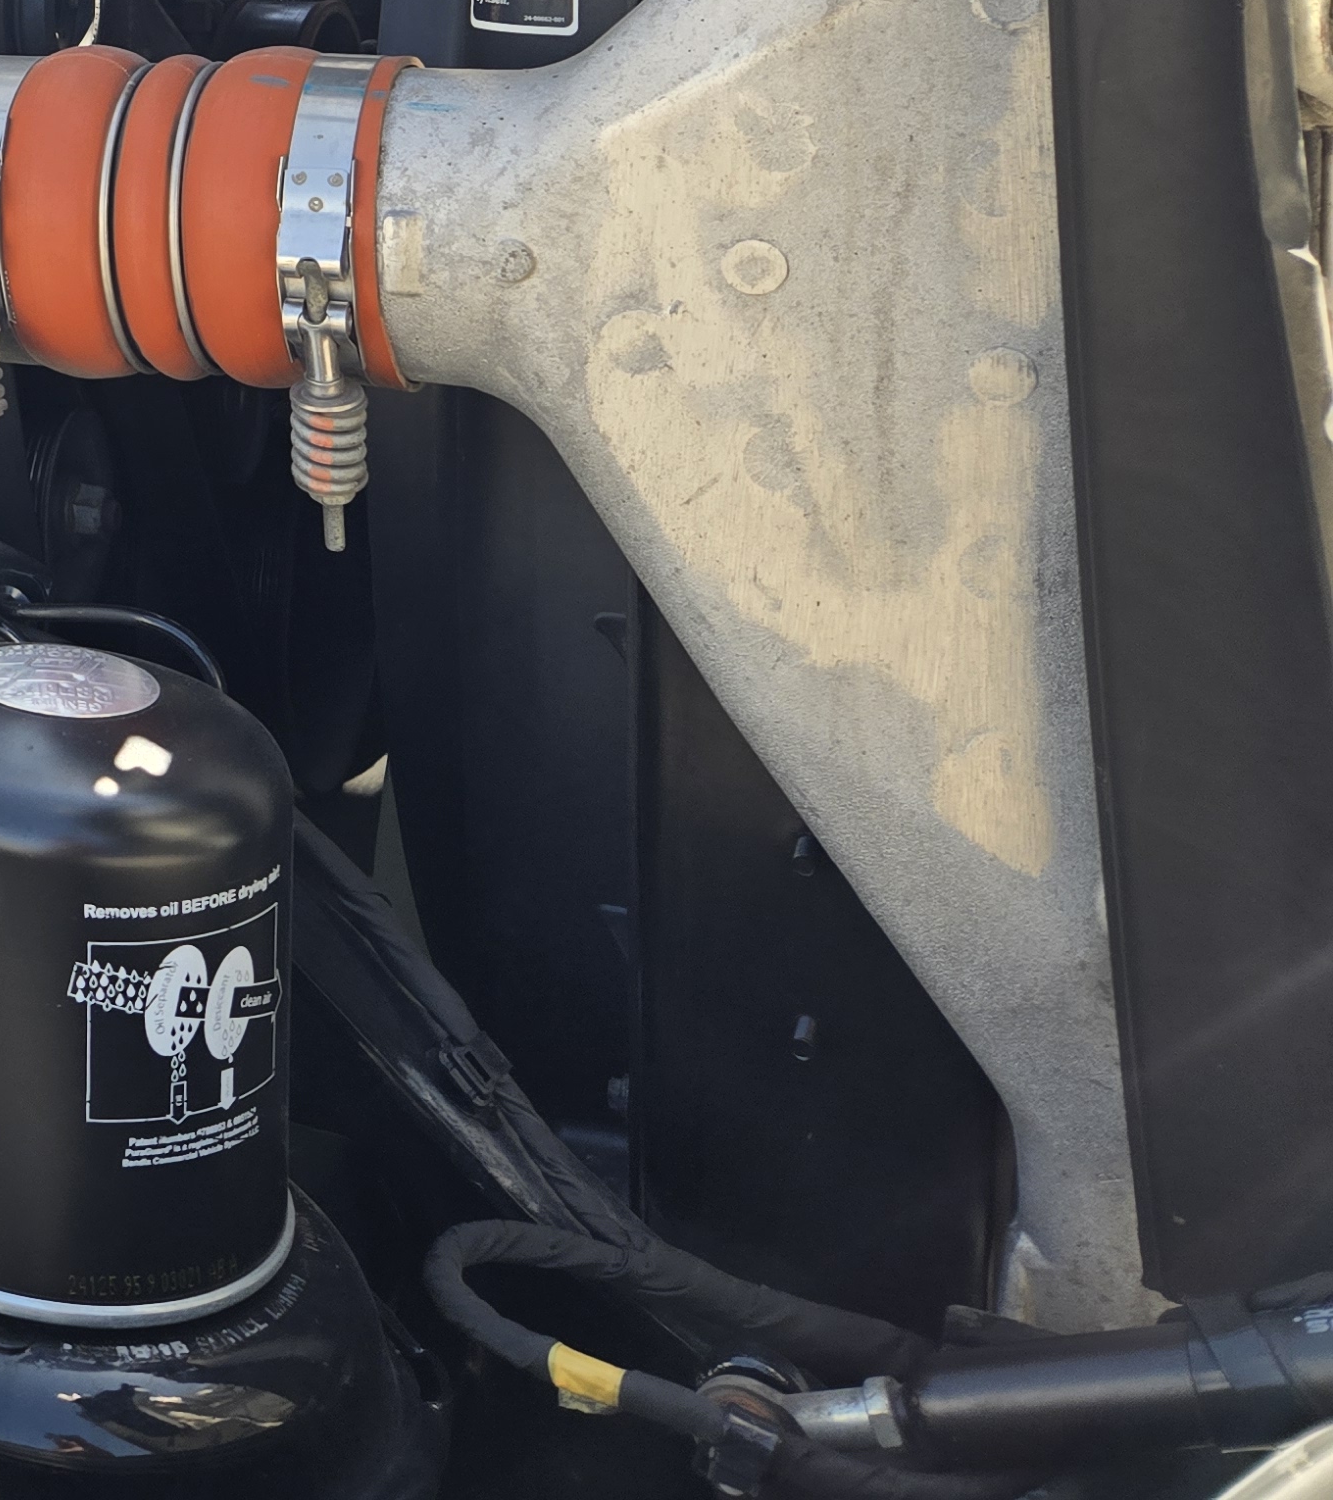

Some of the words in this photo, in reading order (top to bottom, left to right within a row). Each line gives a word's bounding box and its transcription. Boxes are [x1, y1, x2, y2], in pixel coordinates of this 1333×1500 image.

[83, 903, 158, 919] Removes
[160, 901, 179, 917] oil
[182, 888, 237, 915] BEFORE
[238, 876, 268, 899] drying
[212, 974, 231, 1032] Desiccant
[240, 994, 262, 1008] clean
[261, 991, 272, 1005] air
